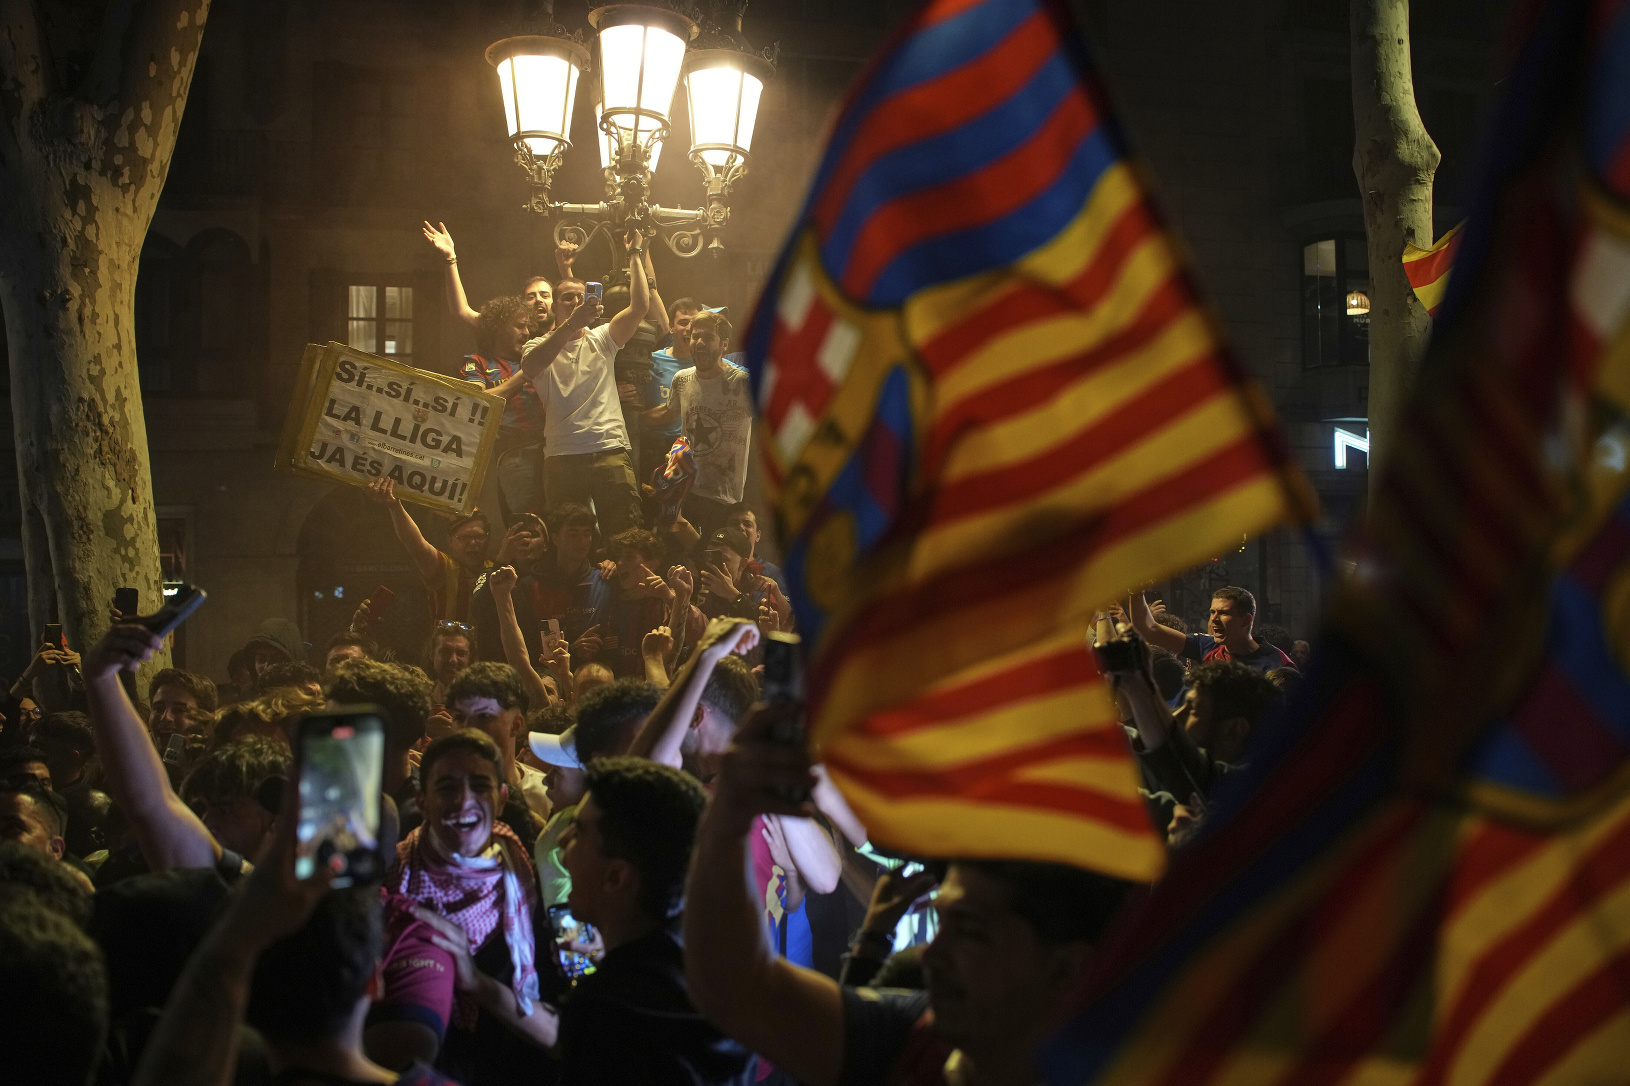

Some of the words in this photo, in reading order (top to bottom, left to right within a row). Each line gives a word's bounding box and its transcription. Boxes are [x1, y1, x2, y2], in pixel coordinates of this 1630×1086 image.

[324, 398, 362, 427] LA
[370, 410, 463, 459] LLIGA
[467, 402, 490, 427] !!
[309, 441, 346, 469] JA
[350, 451, 383, 478] ÉS
[385, 464, 468, 504] AQUÍ!
